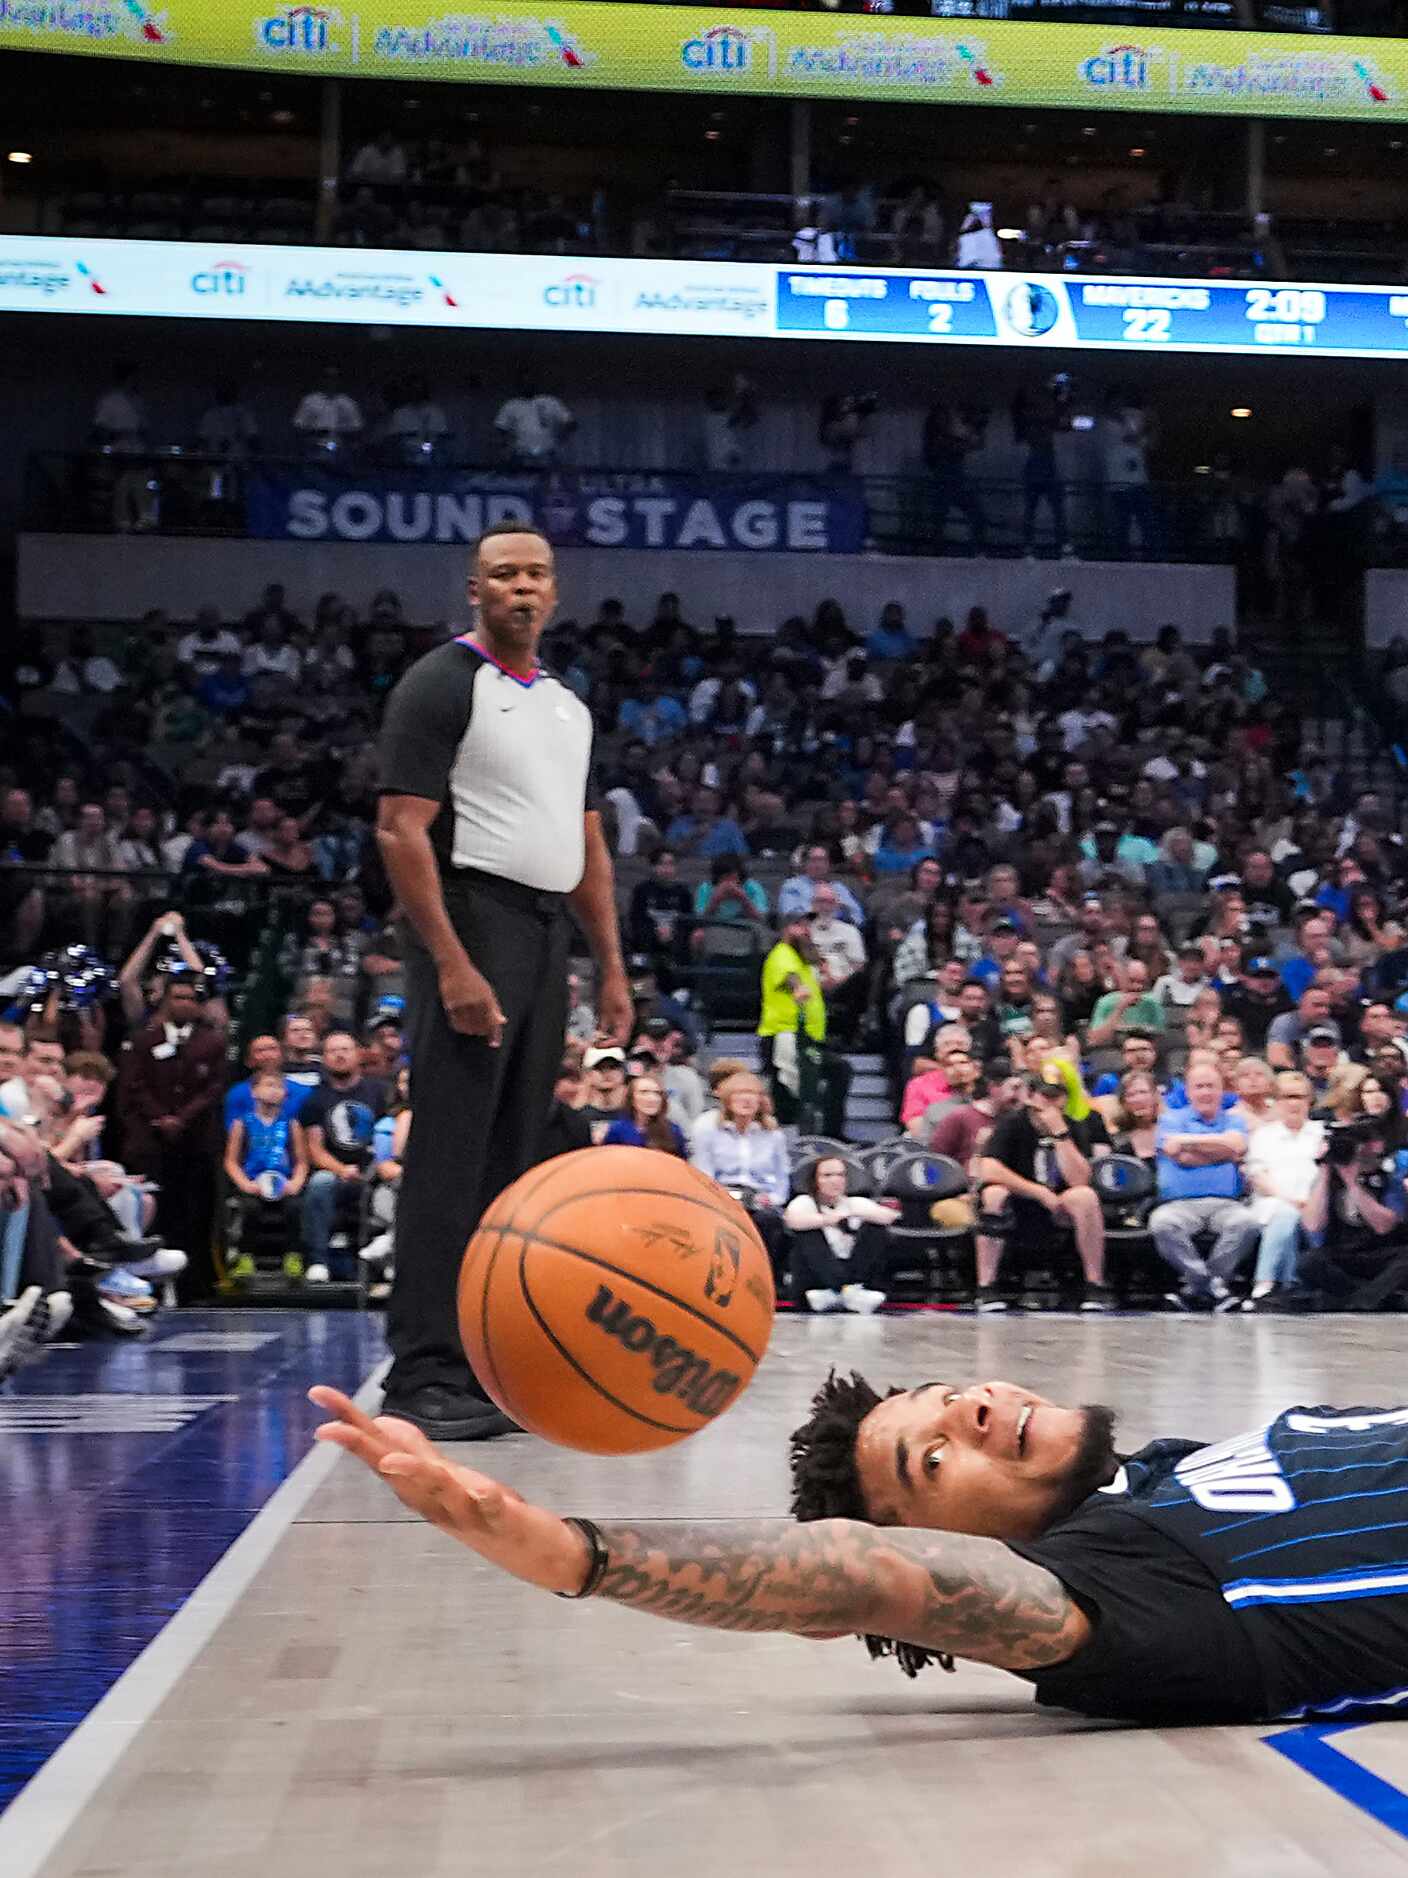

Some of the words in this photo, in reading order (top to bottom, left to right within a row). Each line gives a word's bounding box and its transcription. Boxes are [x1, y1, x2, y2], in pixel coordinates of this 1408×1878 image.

[190, 267, 247, 297] citi
[543, 278, 597, 309] citi
[928, 303, 954, 334] 2
[1122, 308, 1172, 342] 22
[286, 489, 534, 542] SOUND
[586, 495, 829, 549] STAGE
